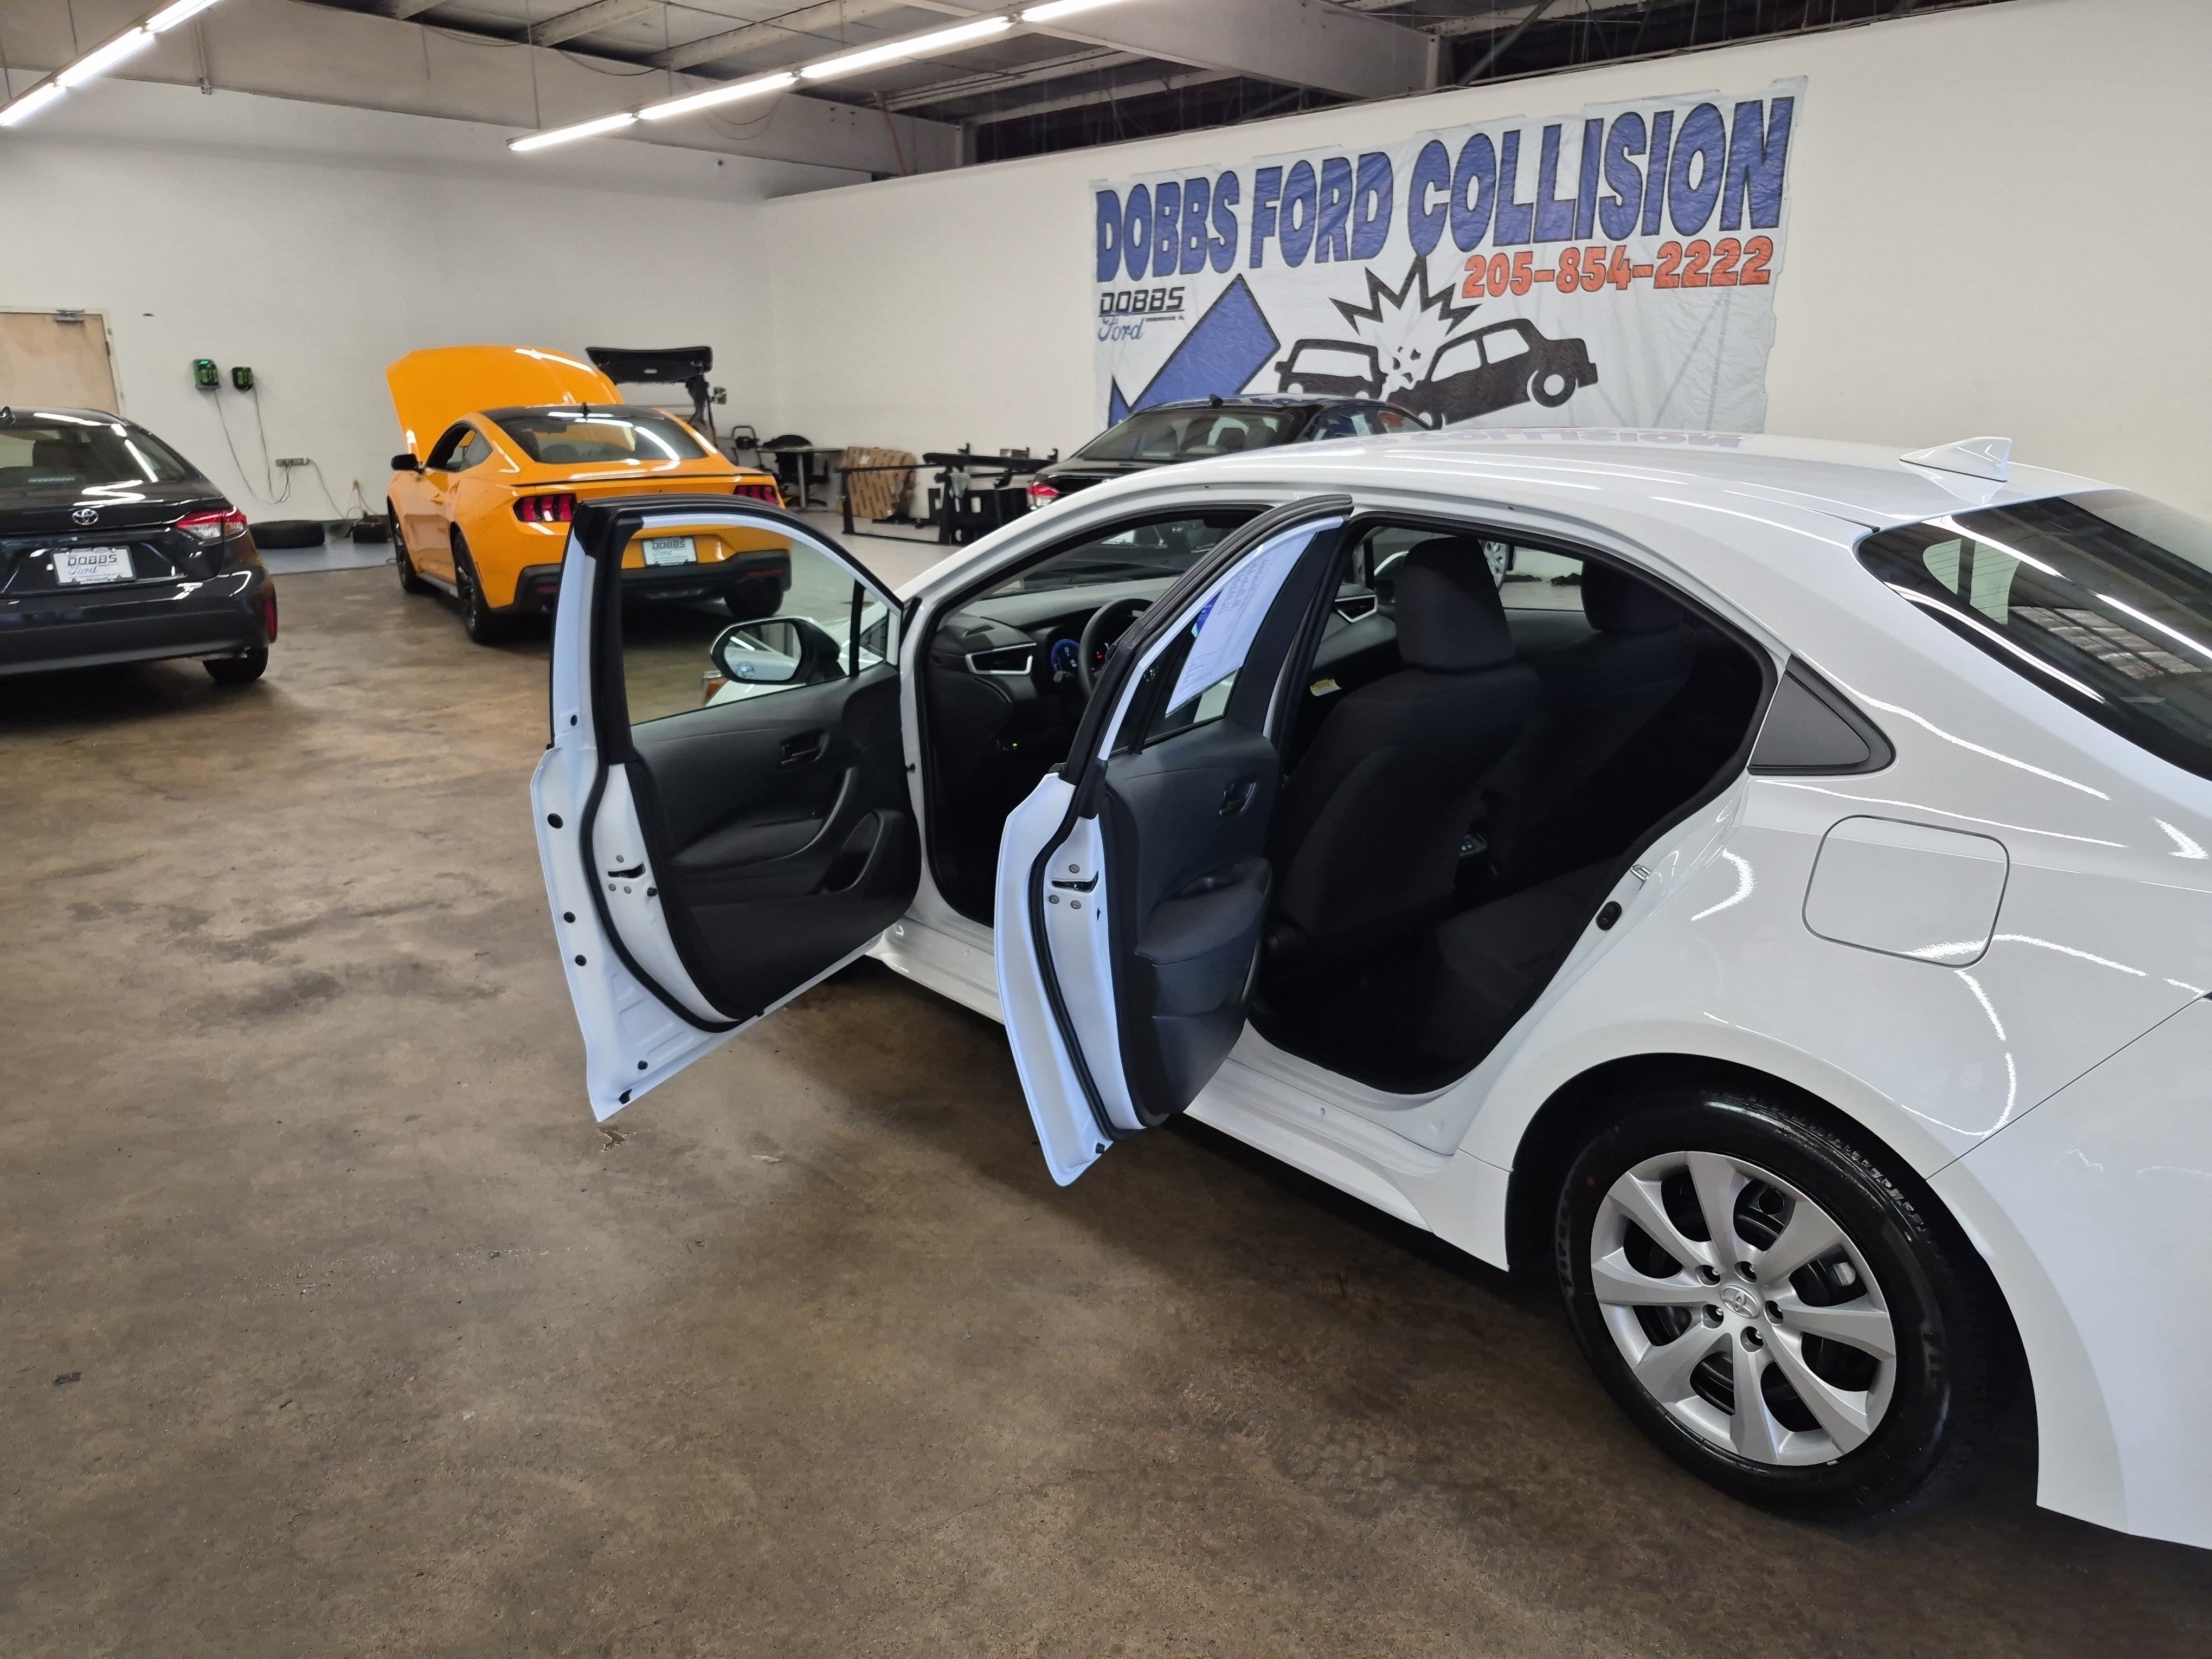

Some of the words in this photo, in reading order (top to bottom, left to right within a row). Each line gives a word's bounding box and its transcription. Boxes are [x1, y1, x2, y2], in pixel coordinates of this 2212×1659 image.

[1096, 170, 1240, 283] DOBBS
[1249, 151, 1393, 268] FORD
[1407, 95, 1794, 256] COLLISION
[1462, 235, 1774, 299] 205-854-2222
[1099, 286, 1185, 314] DOBBS
[1097, 311, 1145, 342] Ford
[67, 554, 117, 566] DOBBS
[68, 565, 98, 575] Ford
